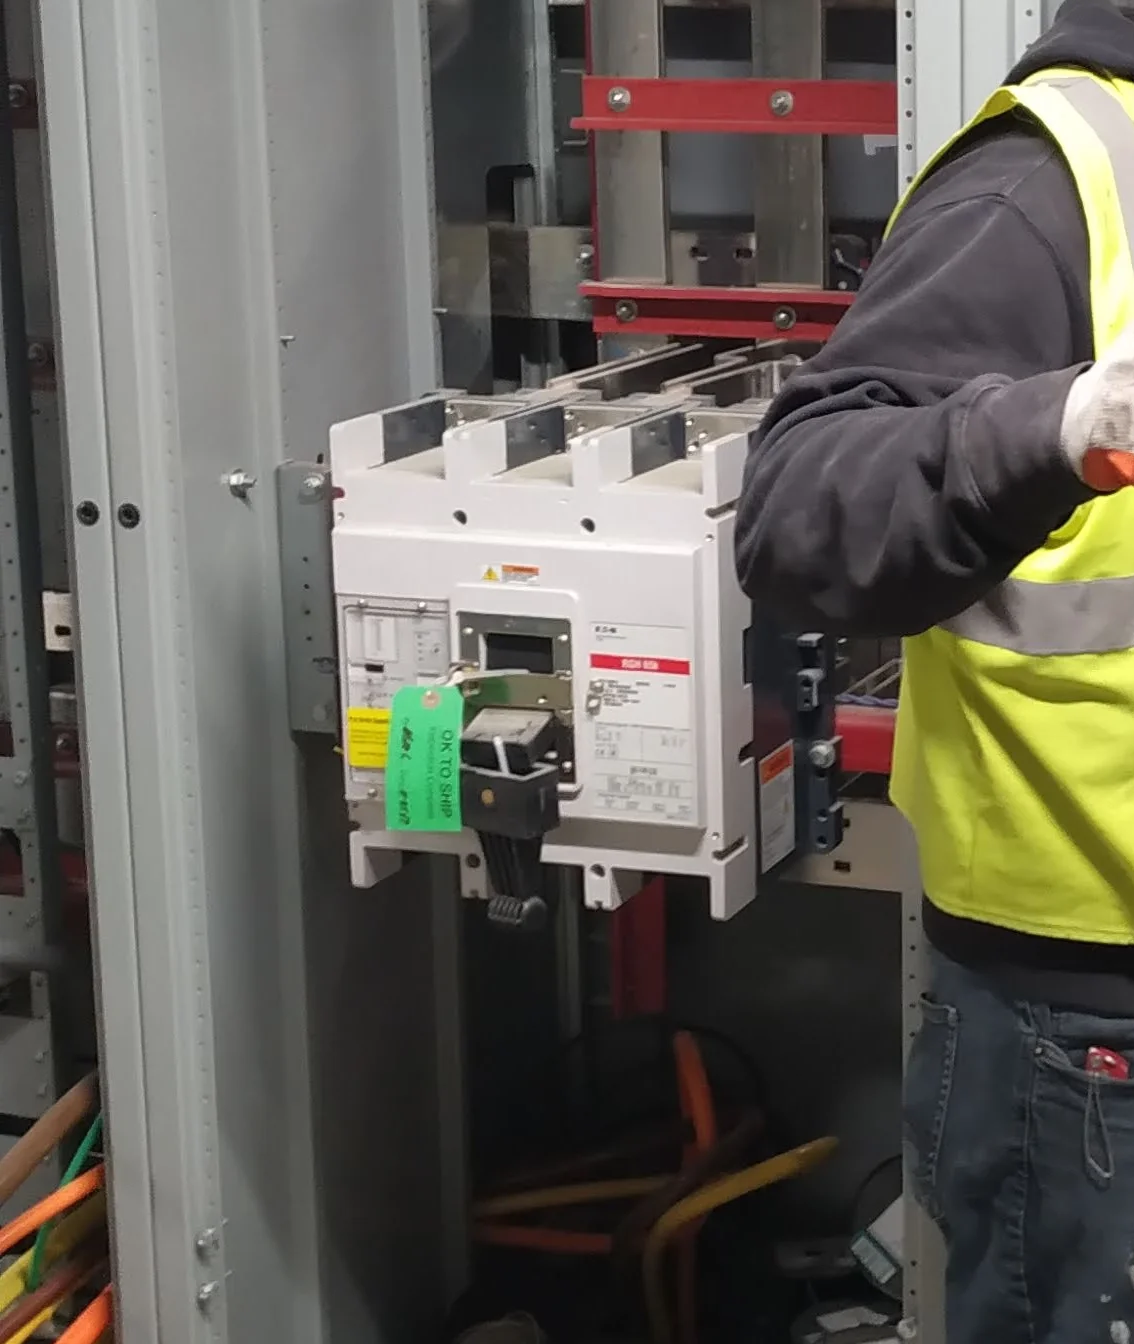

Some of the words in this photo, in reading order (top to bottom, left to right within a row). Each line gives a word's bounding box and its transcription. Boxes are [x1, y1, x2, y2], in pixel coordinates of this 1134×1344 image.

[442, 729, 455, 752] OK
[440, 759, 454, 780] TO
[439, 783, 454, 819] SHIP
